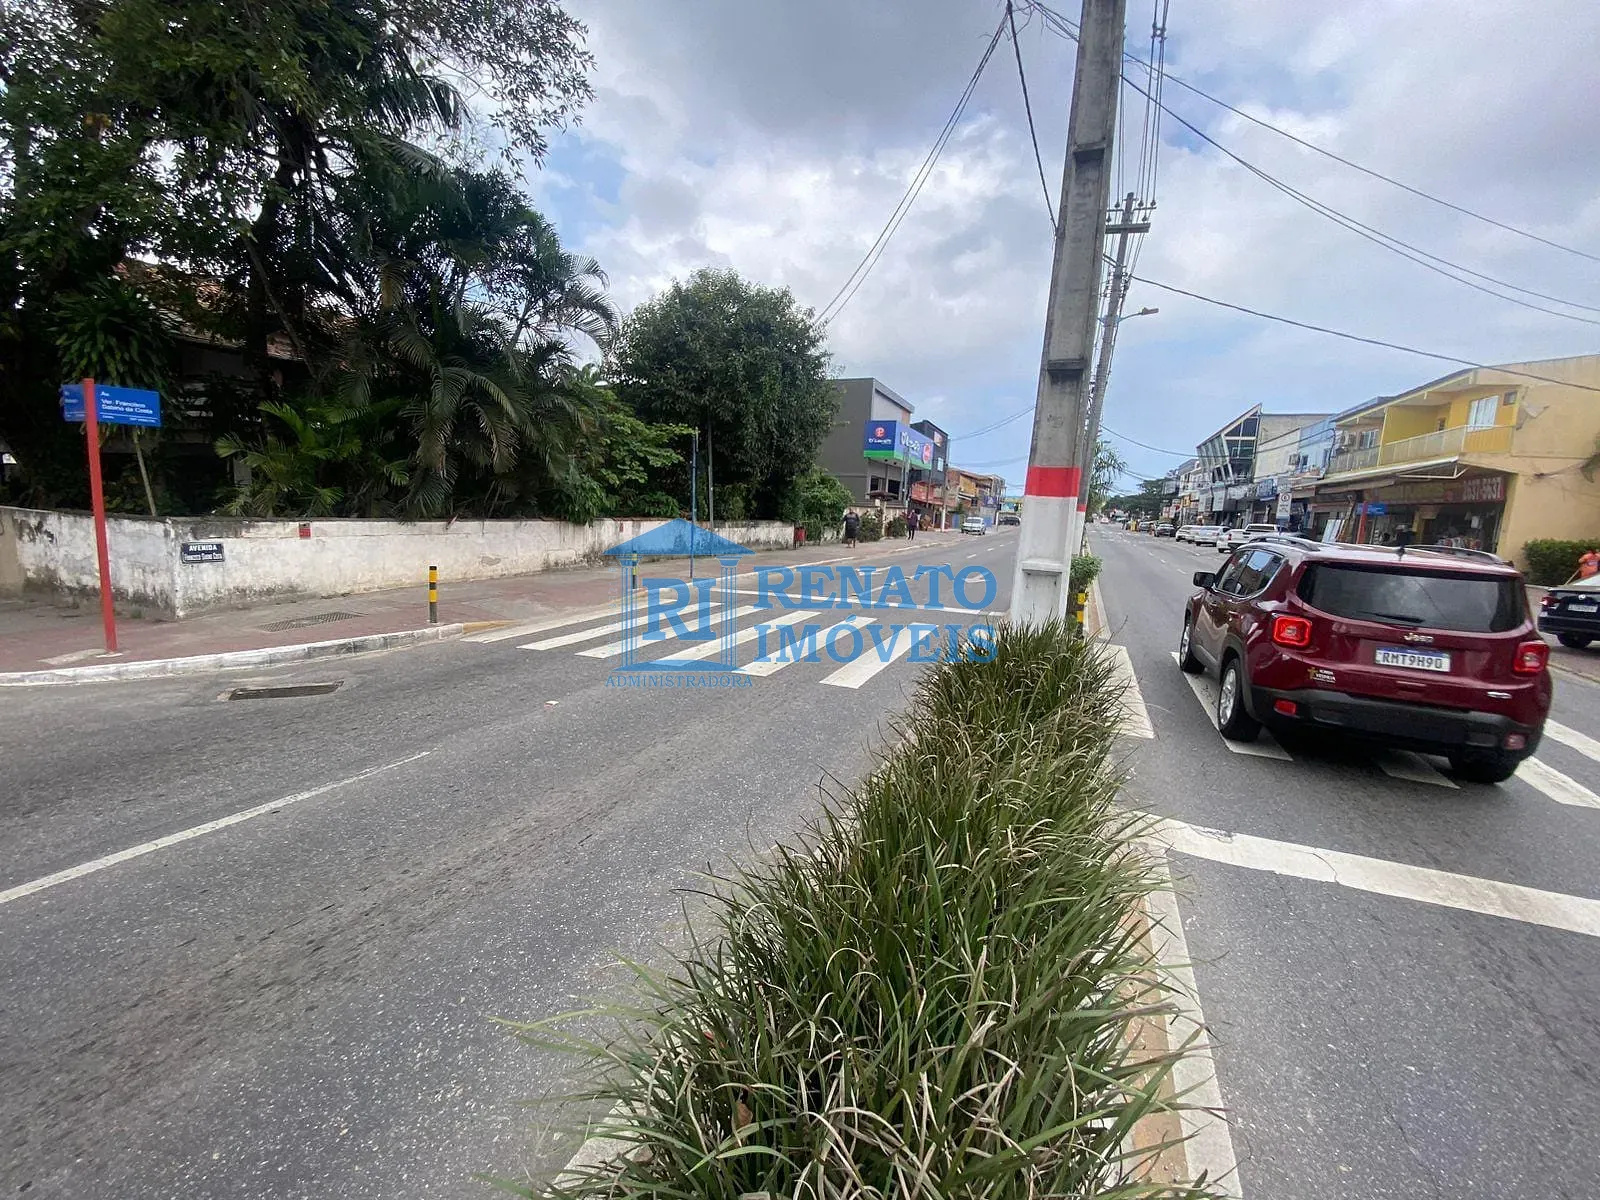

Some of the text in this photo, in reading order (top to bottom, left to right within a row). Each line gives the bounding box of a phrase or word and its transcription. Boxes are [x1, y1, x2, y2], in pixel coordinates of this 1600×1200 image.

[115, 400, 146, 408] Francisco
[189, 544, 218, 552] AVENIDA
[1404, 632, 1434, 643] Jeep
[1382, 652, 1443, 669] RMT9H90
